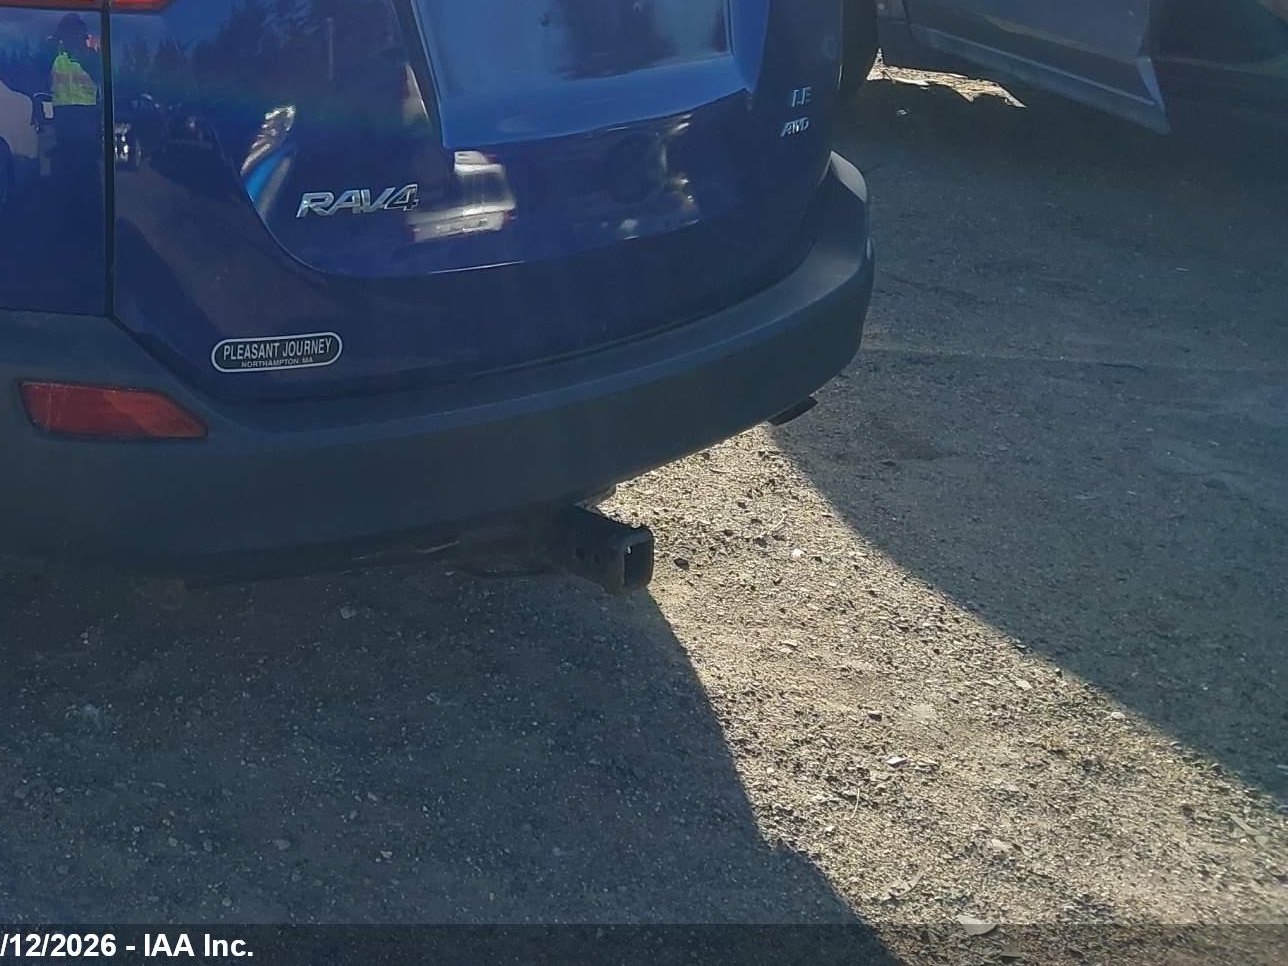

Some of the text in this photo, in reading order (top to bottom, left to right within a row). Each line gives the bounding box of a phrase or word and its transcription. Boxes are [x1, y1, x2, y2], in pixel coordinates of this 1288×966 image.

[780, 117, 809, 137] AWD
[296, 184, 419, 218] RAV4
[223, 338, 332, 360] PLEASANT JOURNEY
